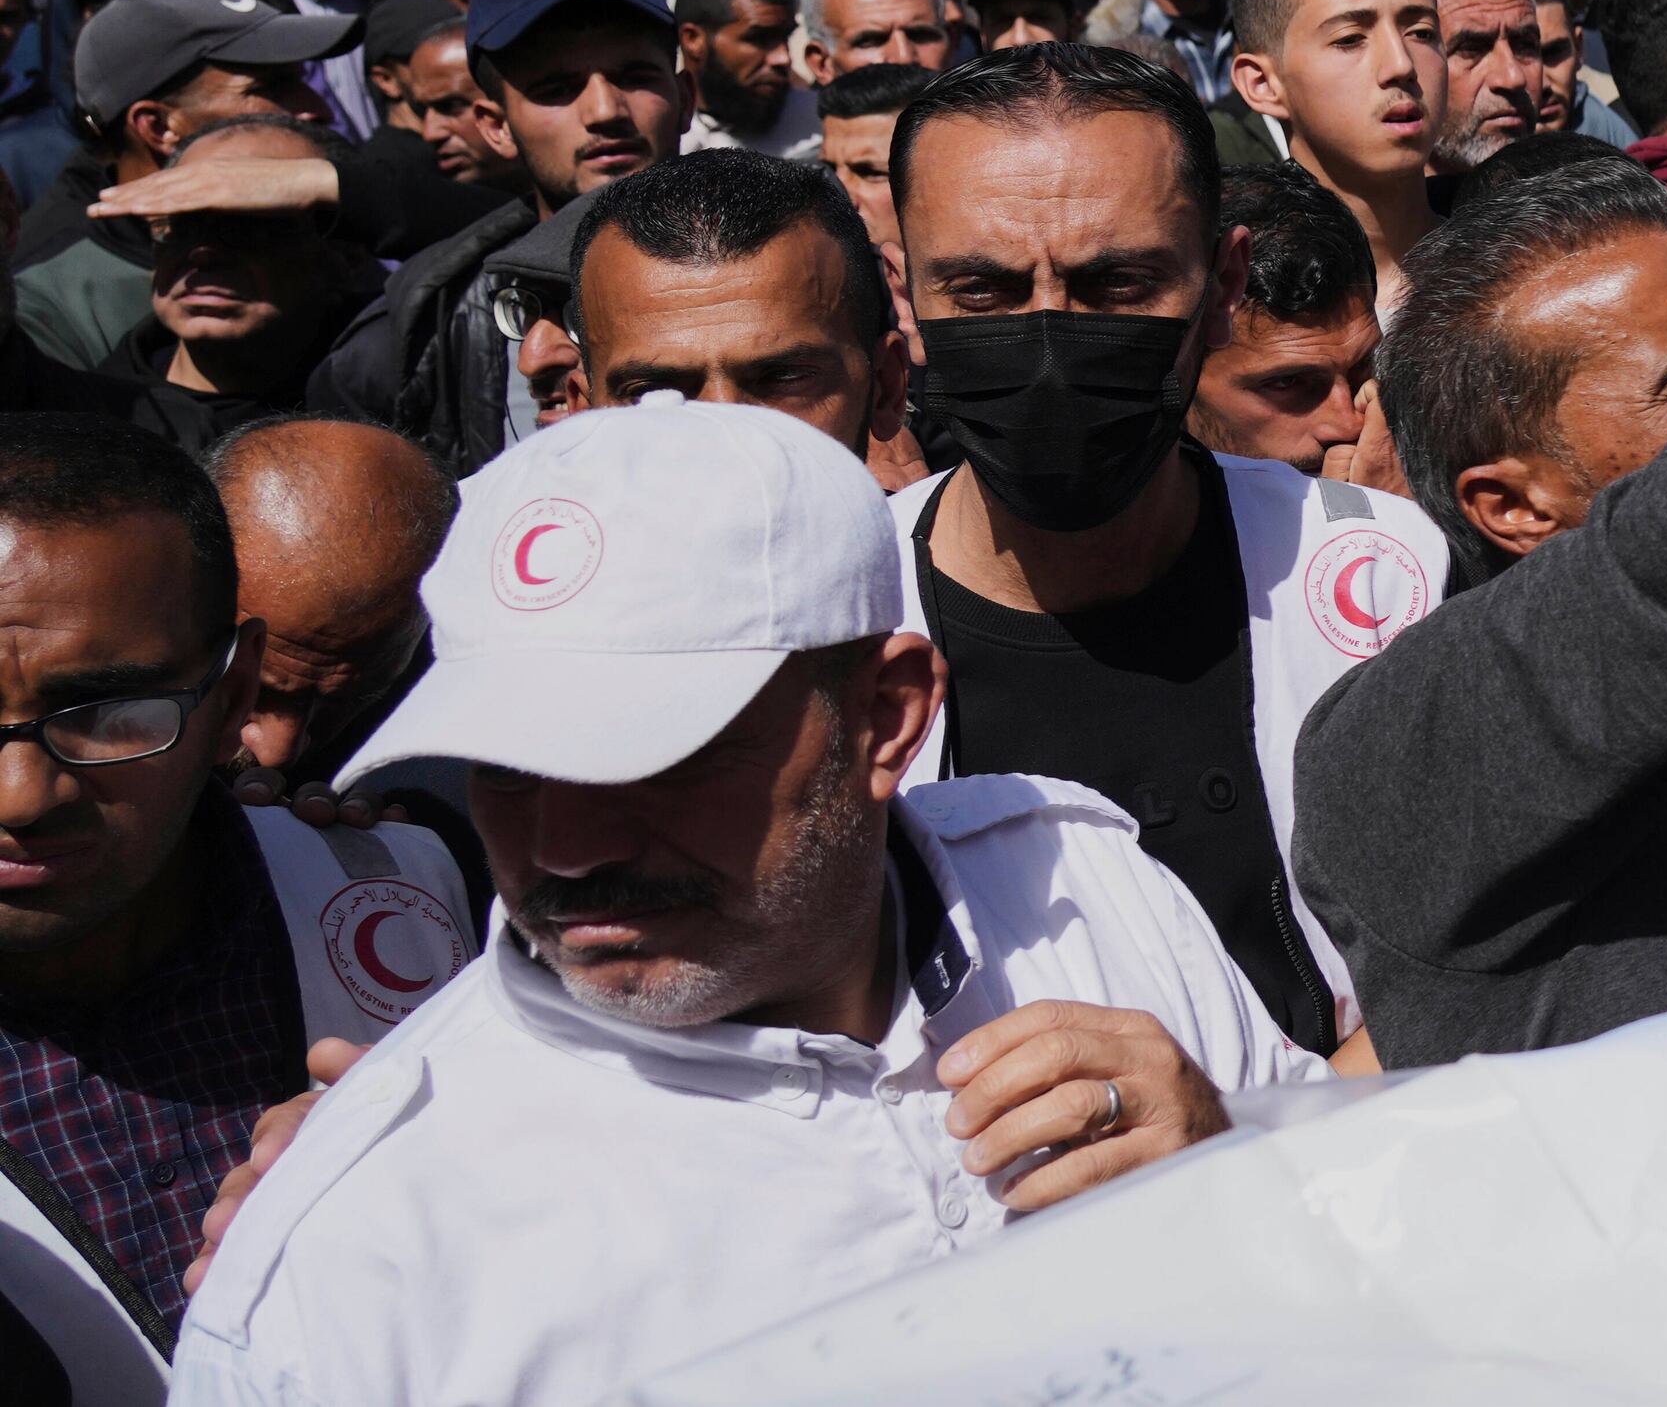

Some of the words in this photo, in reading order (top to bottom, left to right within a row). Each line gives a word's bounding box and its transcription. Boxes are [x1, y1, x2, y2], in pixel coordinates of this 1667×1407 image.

[1321, 613, 1360, 648] PALESTINE
[1405, 585, 1420, 623] SOCIETY
[380, 887, 421, 909] الهلال
[420, 902, 452, 933] جمعية
[344, 974, 396, 1014] PALESTINE
[447, 939, 463, 982] SOCIETY
